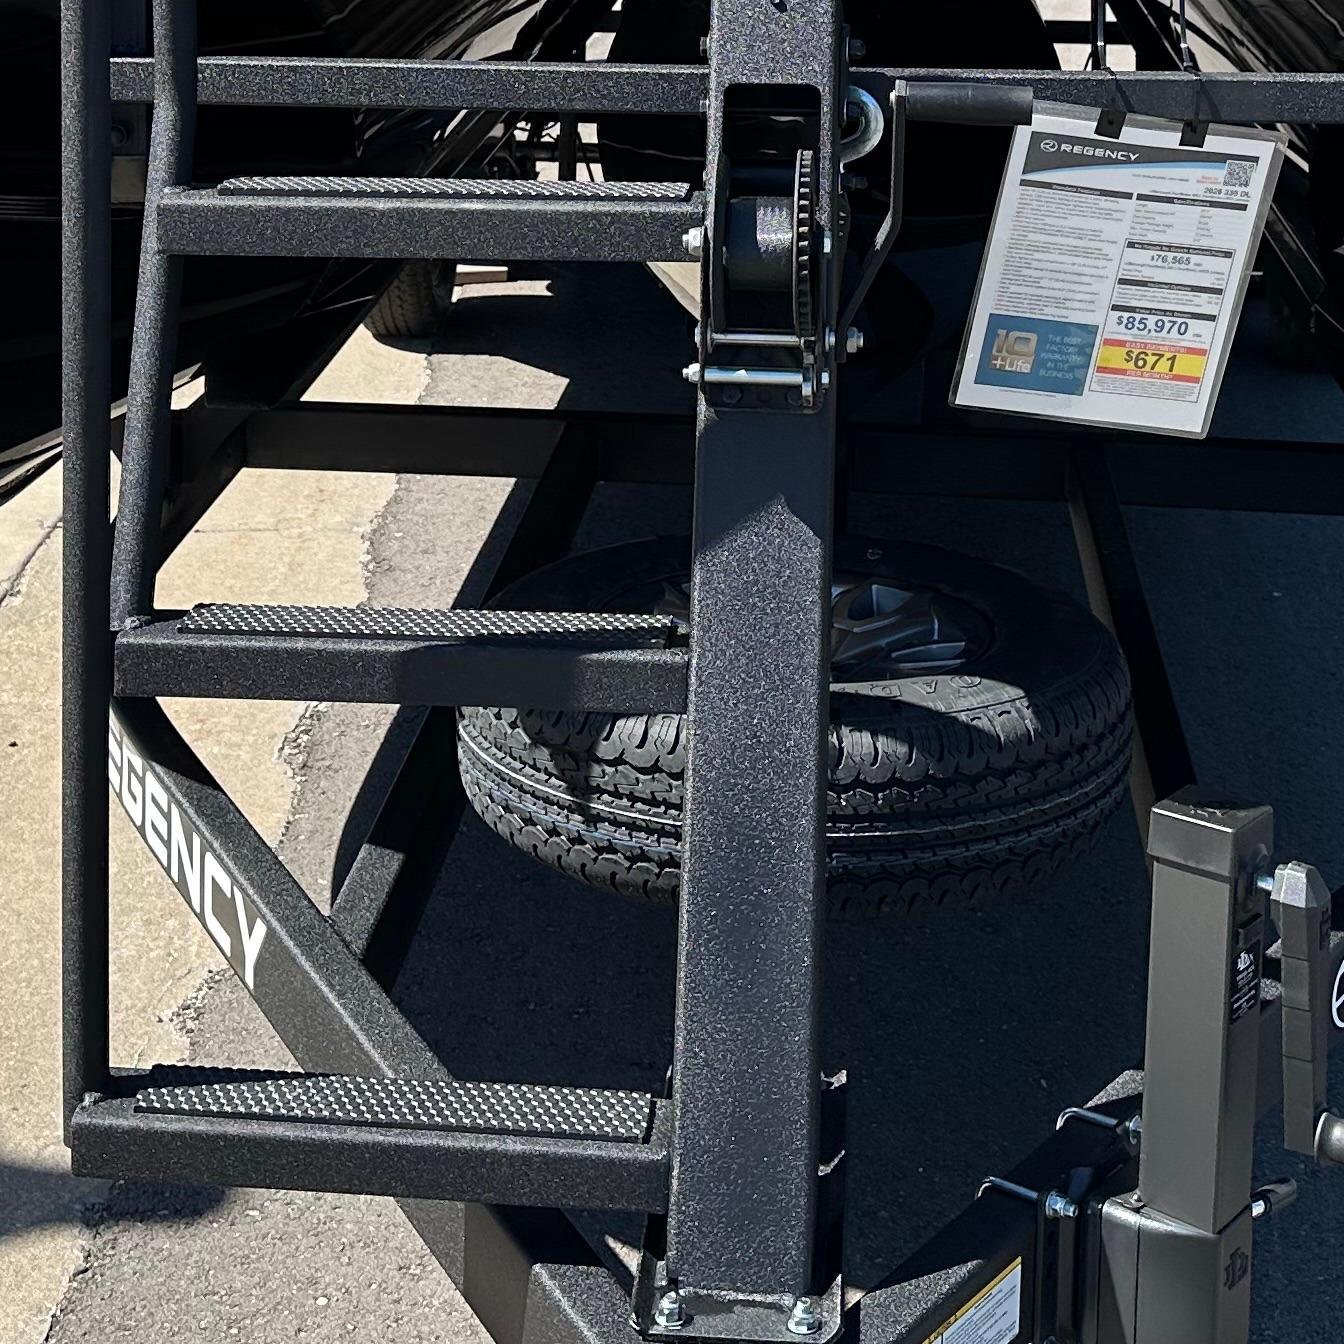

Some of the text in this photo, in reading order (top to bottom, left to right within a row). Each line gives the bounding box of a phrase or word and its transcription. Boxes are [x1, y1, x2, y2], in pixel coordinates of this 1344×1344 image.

[1060, 143, 1139, 161] REGENCY
[1116, 314, 1189, 336] $85,970
[1123, 349, 1177, 372] $671
[109, 714, 268, 990] EGENCY
